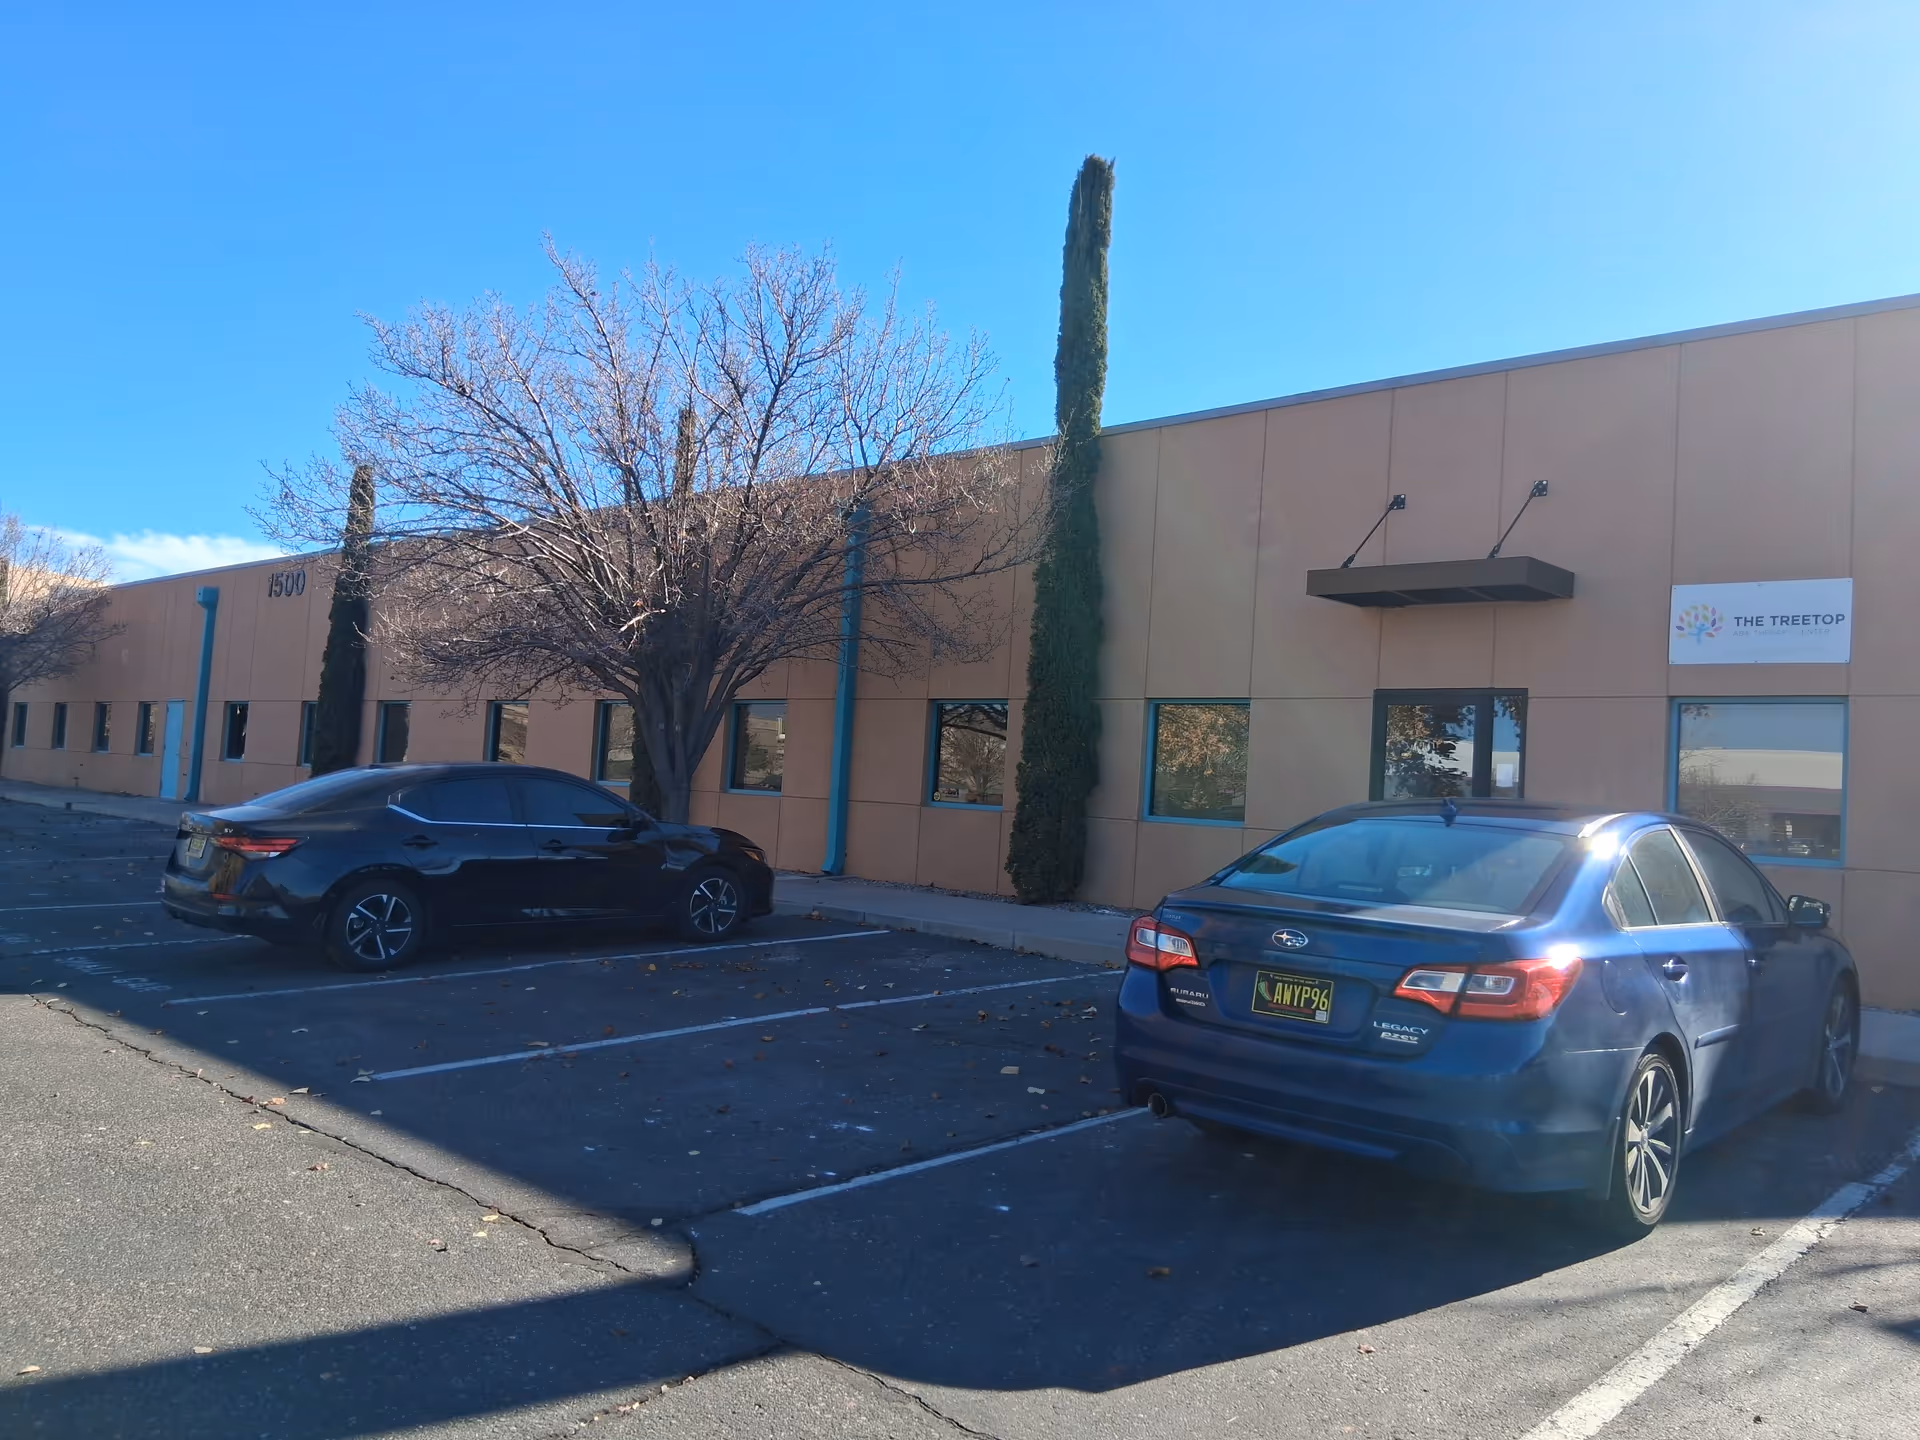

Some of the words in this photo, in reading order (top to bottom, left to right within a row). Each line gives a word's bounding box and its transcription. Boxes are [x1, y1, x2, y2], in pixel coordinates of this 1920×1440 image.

[268, 569, 306, 598] 1500
[1734, 615, 1765, 627] THE
[1770, 613, 1846, 626] TREETOP
[1170, 987, 1209, 999] SUBARU
[1273, 982, 1329, 1011] AWYP96
[1373, 1020, 1429, 1035] LEGACY
